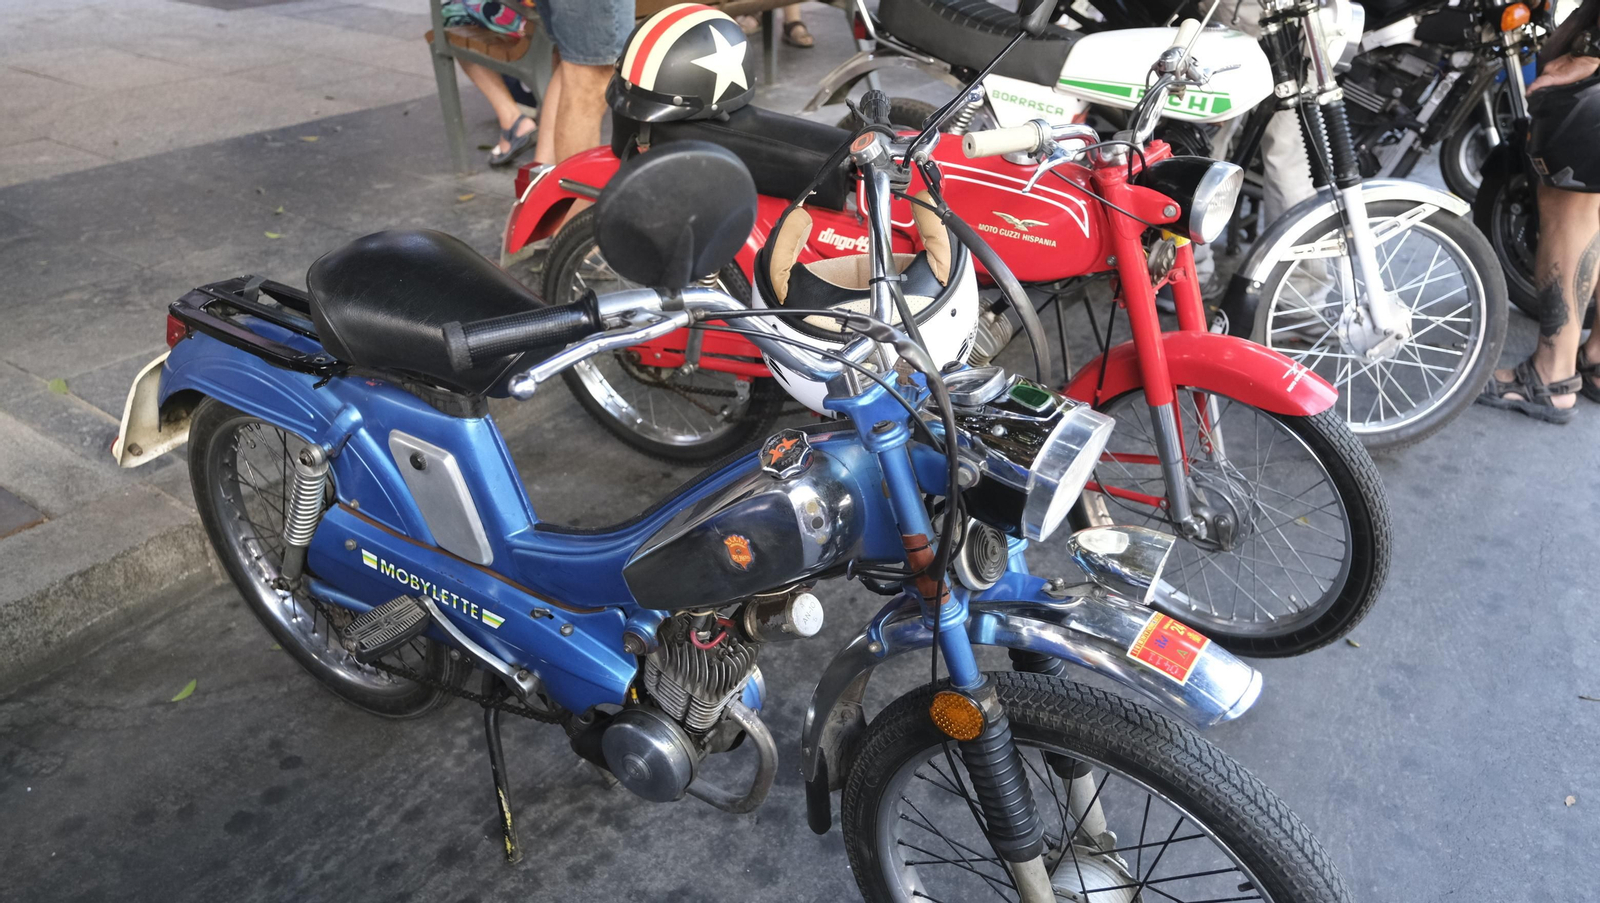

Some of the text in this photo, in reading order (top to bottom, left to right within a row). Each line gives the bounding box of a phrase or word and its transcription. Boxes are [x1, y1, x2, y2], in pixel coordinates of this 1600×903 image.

[992, 89, 1064, 116] BORRASCA
[978, 223, 1057, 247] MOTO GUZZI HISPANIA
[380, 558, 479, 620] MOBYLETTE
[1170, 622, 1187, 636] 24
[1154, 634, 1169, 649] itv
[1176, 649, 1189, 660] A
